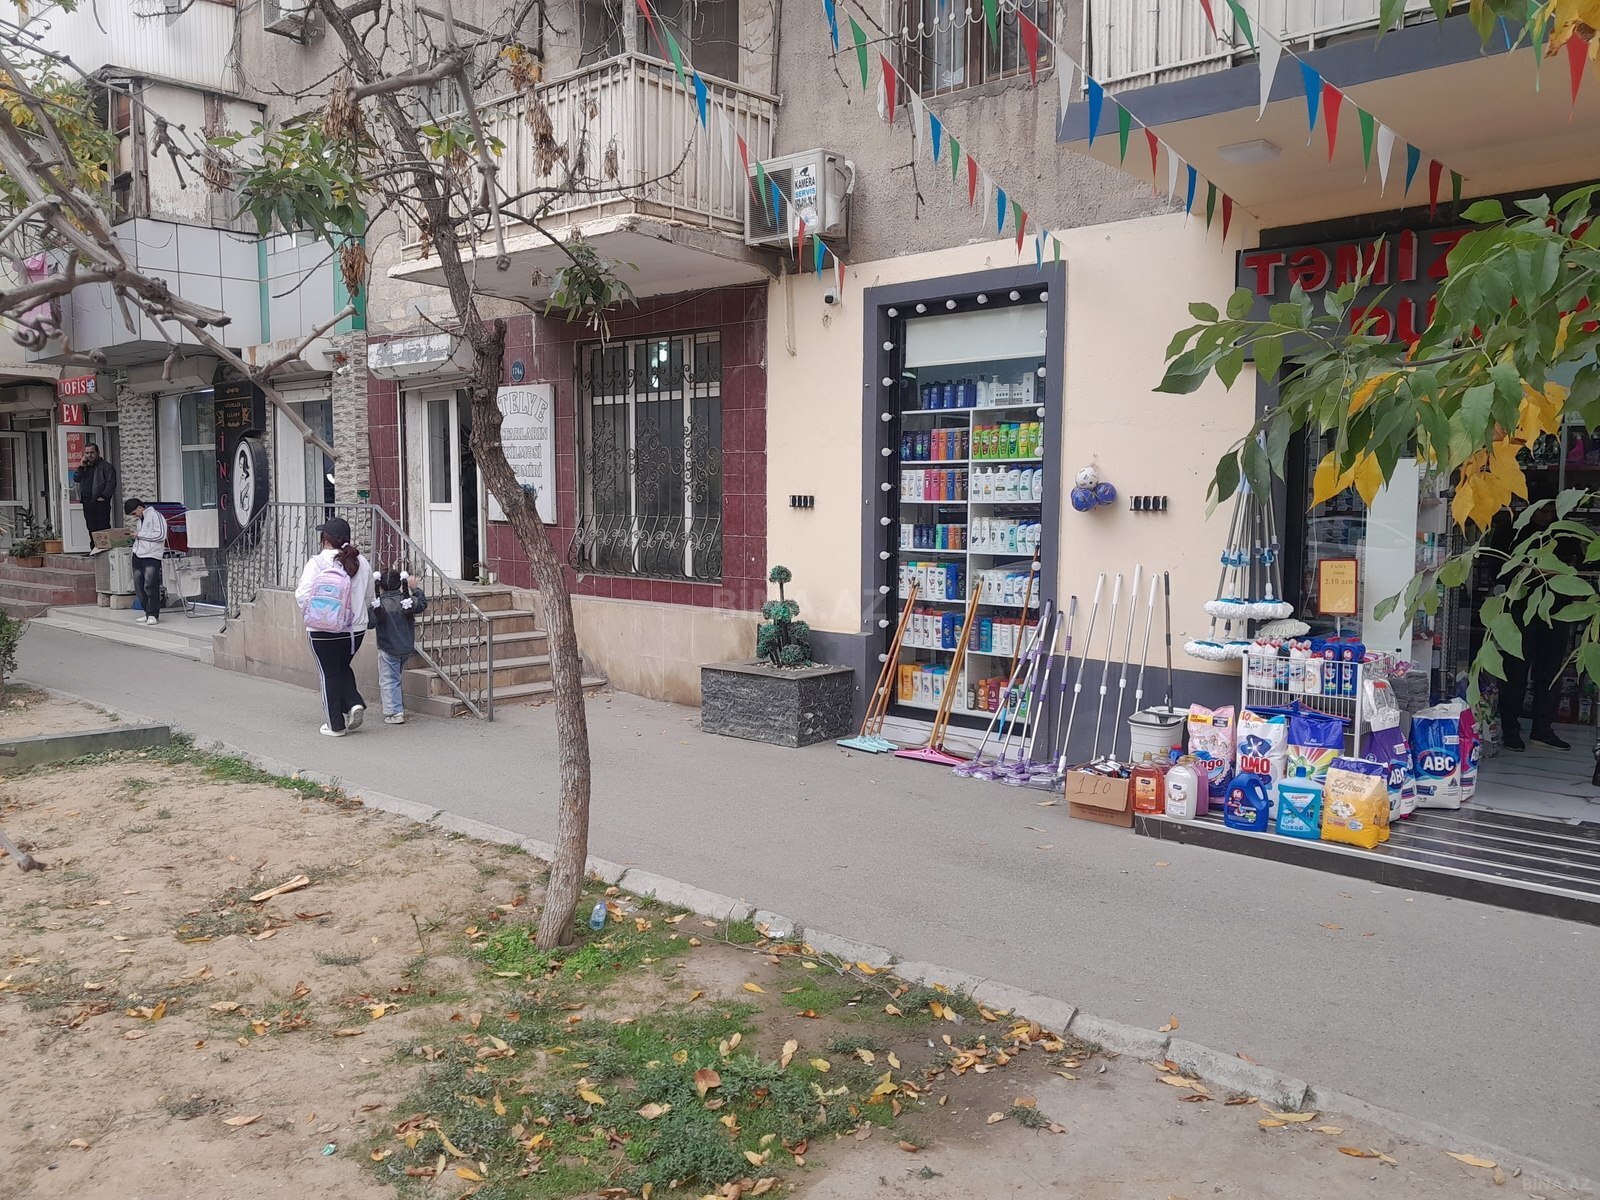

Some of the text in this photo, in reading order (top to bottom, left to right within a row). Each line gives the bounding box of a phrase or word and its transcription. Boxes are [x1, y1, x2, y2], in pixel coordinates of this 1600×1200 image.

[795, 176, 816, 190] KAMERA
[65, 378, 86, 394] OFİS
[63, 404, 79, 422] EV
[498, 391, 549, 423] TELYE
[501, 427, 549, 440] TARLARIN
[502, 443, 543, 459] KİLMƏSİ
[1241, 756, 1271, 773] OMO
[1423, 756, 1454, 771] ABC
[1389, 767, 1406, 785] ABC
[1074, 776, 1112, 795] 1.10
